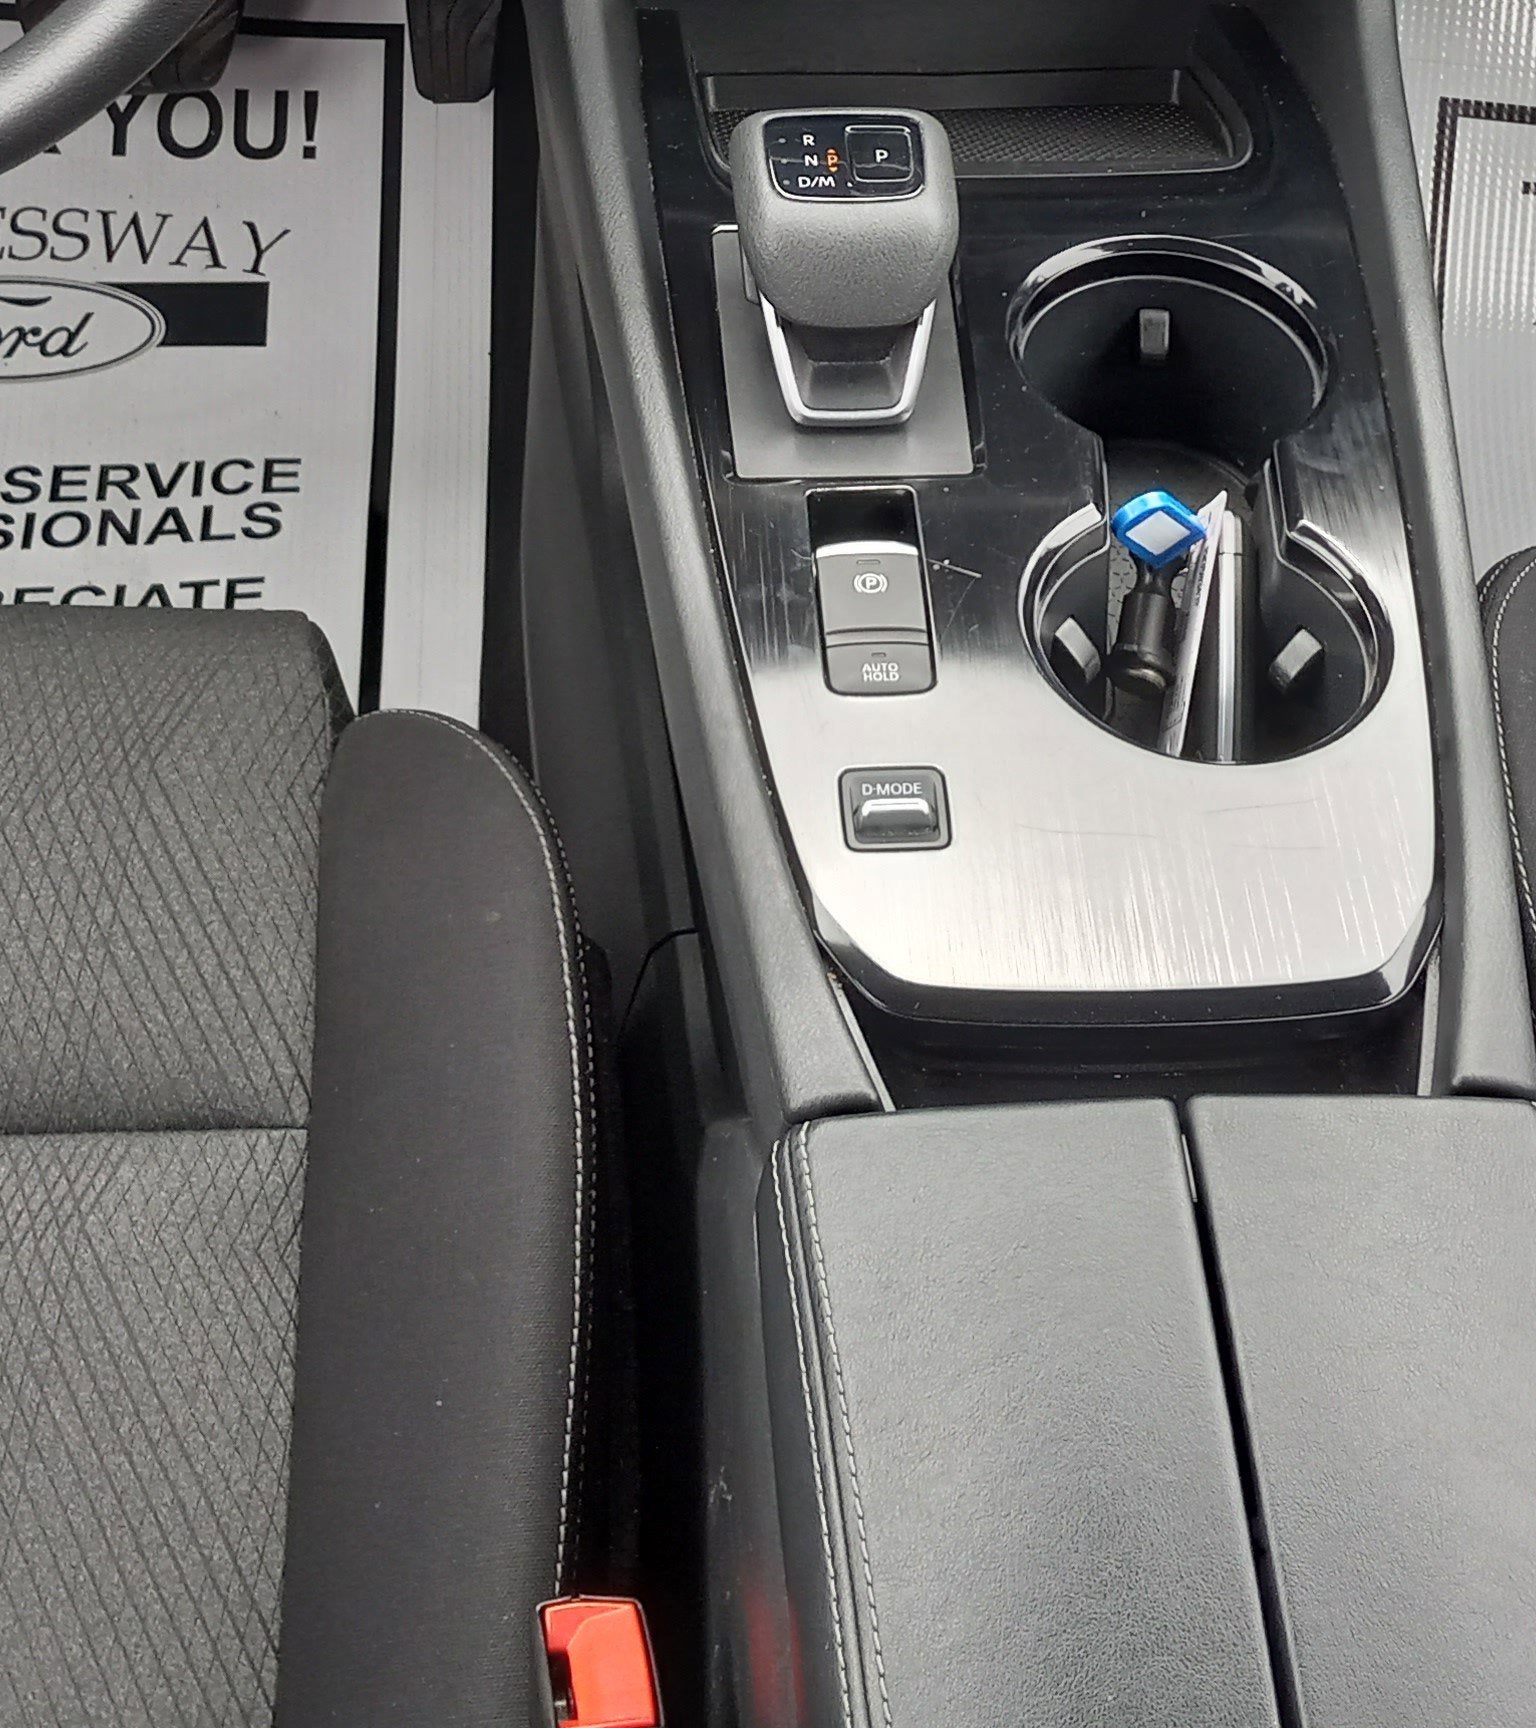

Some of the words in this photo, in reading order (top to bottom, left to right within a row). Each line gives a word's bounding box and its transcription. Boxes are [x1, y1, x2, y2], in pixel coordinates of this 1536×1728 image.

[106, 90, 319, 161] YOU!
[803, 135, 814, 146] R
[805, 155, 818, 166] N
[875, 150, 888, 162] P
[798, 176, 835, 188] D/M
[862, 662, 898, 672] AUTO
[863, 672, 899, 682] HOLD
